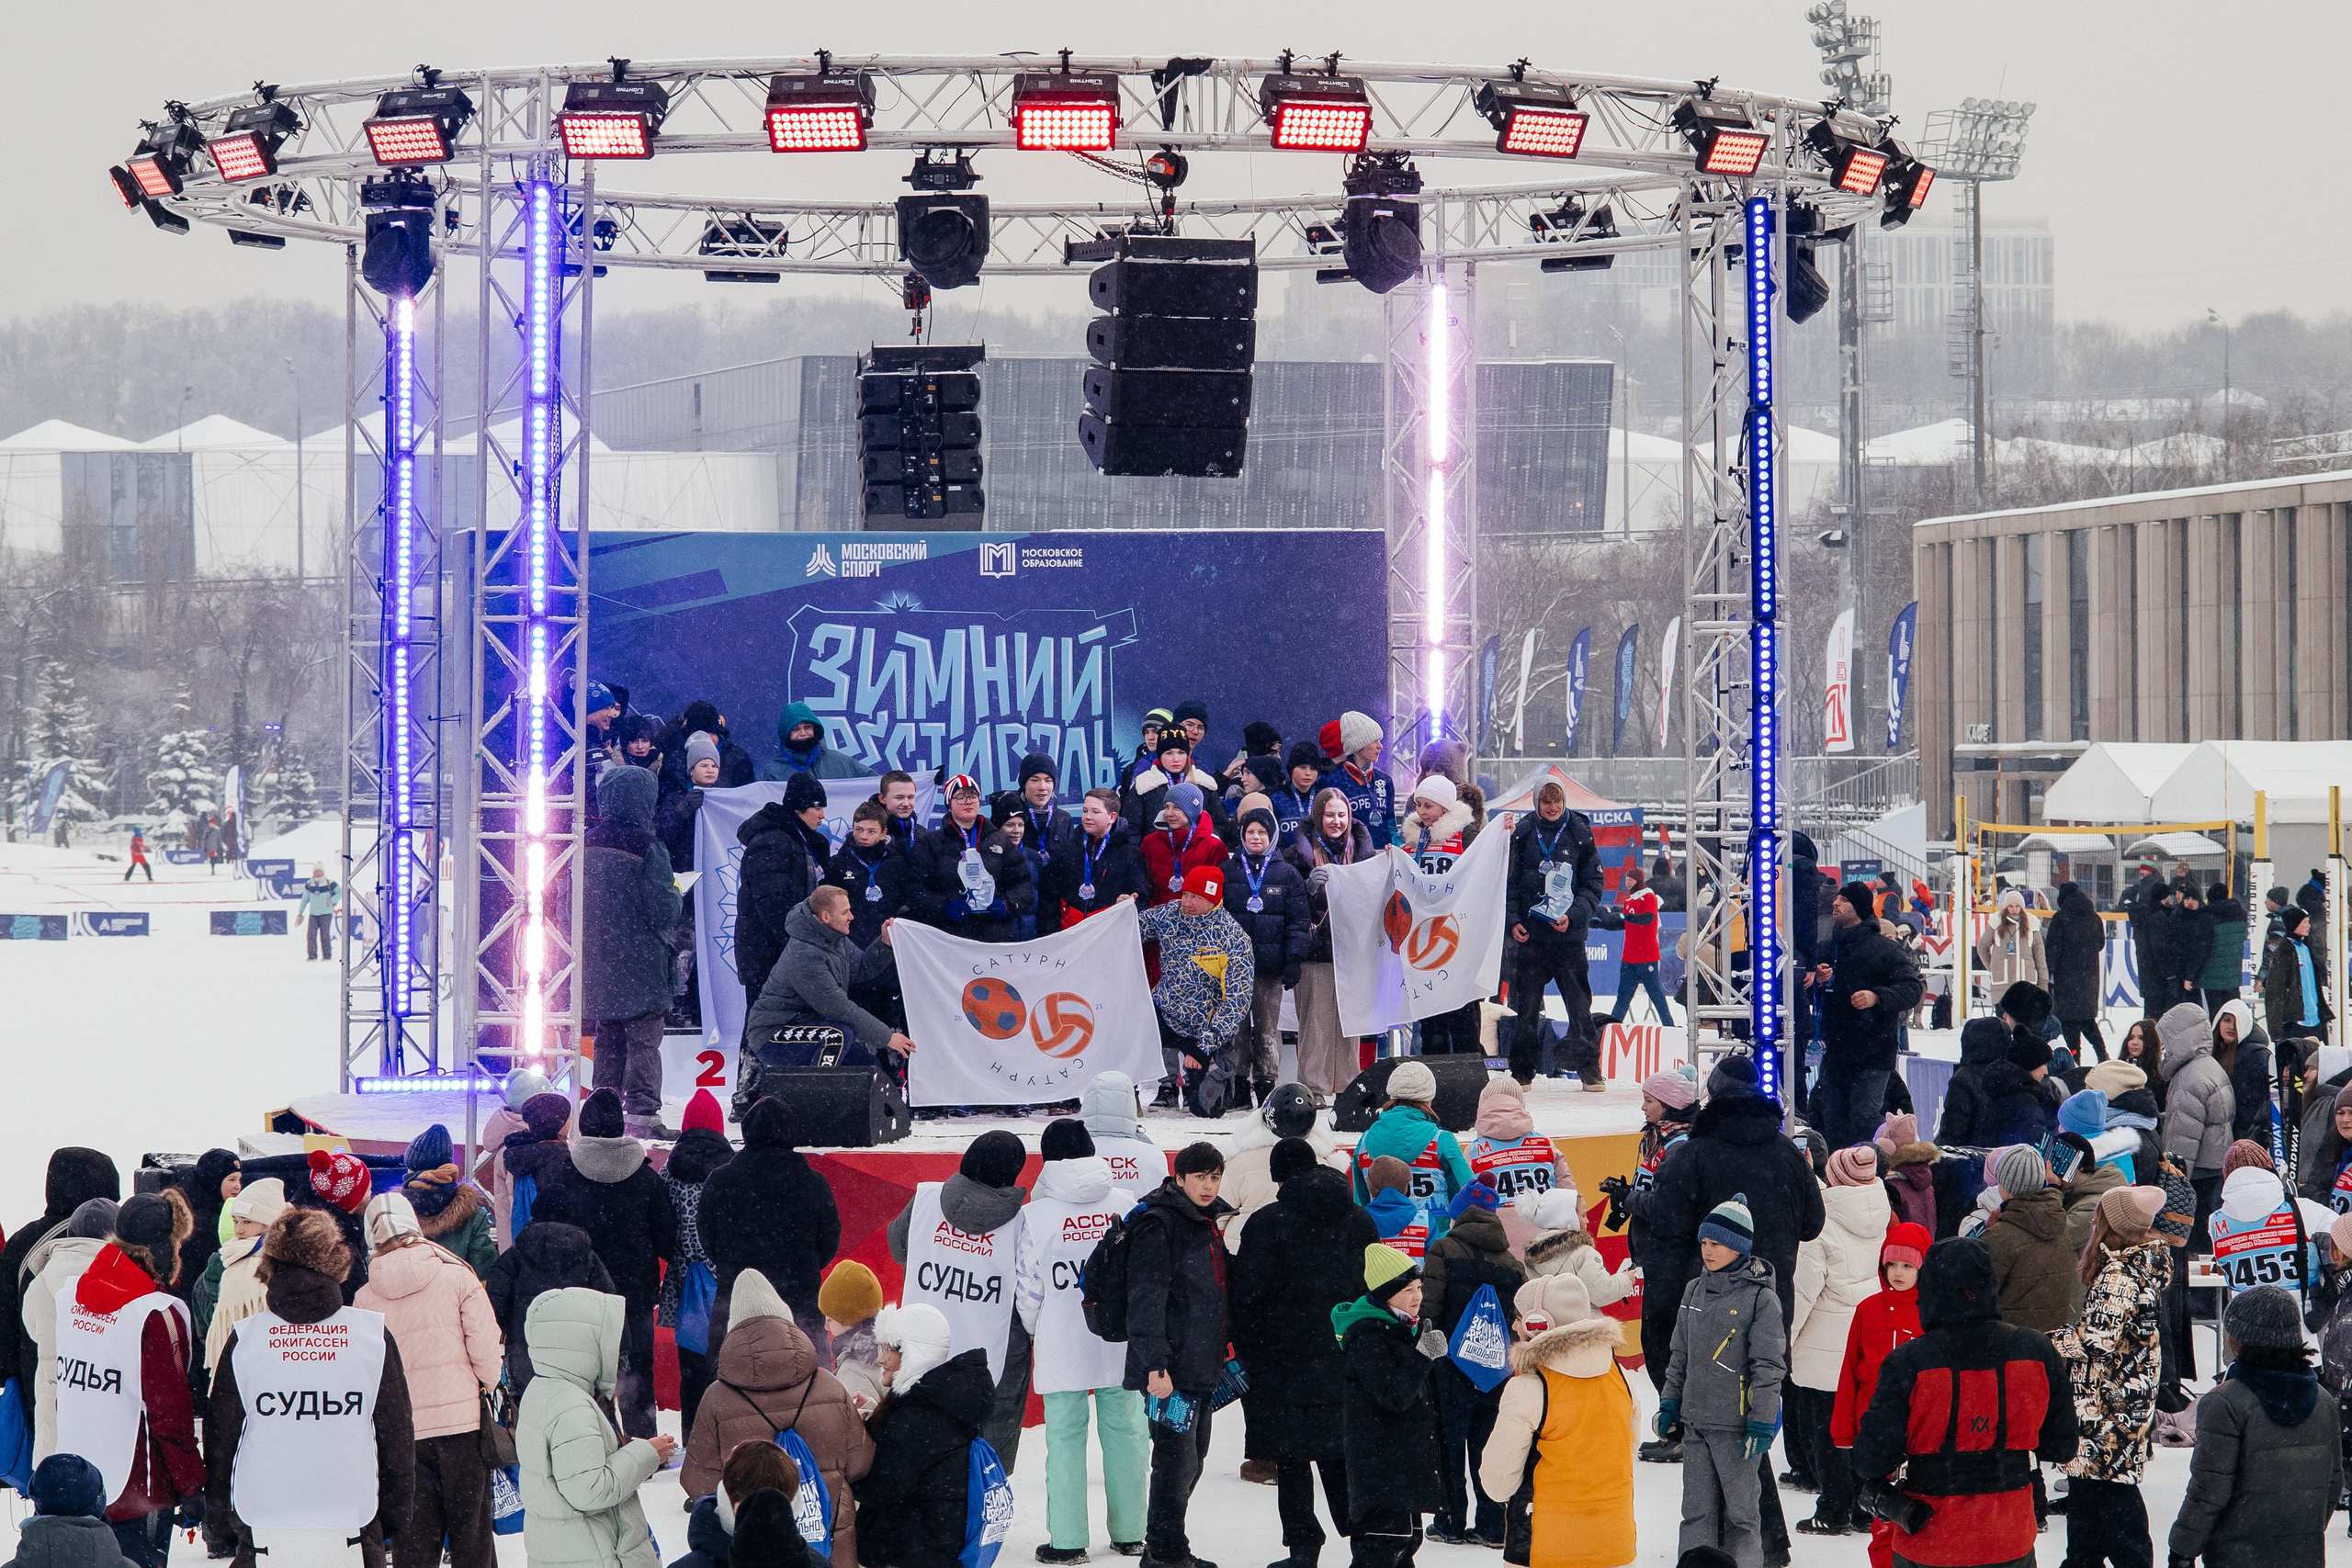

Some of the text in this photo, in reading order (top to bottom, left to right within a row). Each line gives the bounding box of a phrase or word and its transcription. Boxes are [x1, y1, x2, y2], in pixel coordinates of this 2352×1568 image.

[842, 540, 927, 559] МОСКОВСКИЙ
[1022, 548, 1083, 558] МОСКОВСКОЕ
[842, 561, 882, 577] СПОРТ
[1022, 559, 1083, 568] ОБРАЗОВАНИЕ
[804, 623, 1107, 739] ЗИМНИЙ
[1351, 797, 1387, 812] ОРБТА
[1593, 811, 1634, 825] ЦСКА
[972, 953, 1067, 976] САТУРН
[695, 1050, 726, 1088] 2
[990, 1058, 1085, 1086] САТУРН
[933, 1235, 993, 1258] РОССИИ
[918, 1261, 1002, 1304] СУДЬЯ
[73, 1318, 106, 1336] РОССИИ
[268, 1324, 348, 1336] ФЕДЕРАЦИЯ
[269, 1337, 349, 1348] ЮКИГАССЕН
[282, 1351, 336, 1361] РОССИИ
[57, 1355, 122, 1394] СУДЬЯ
[255, 1391, 363, 1420] СУДЬЯ
